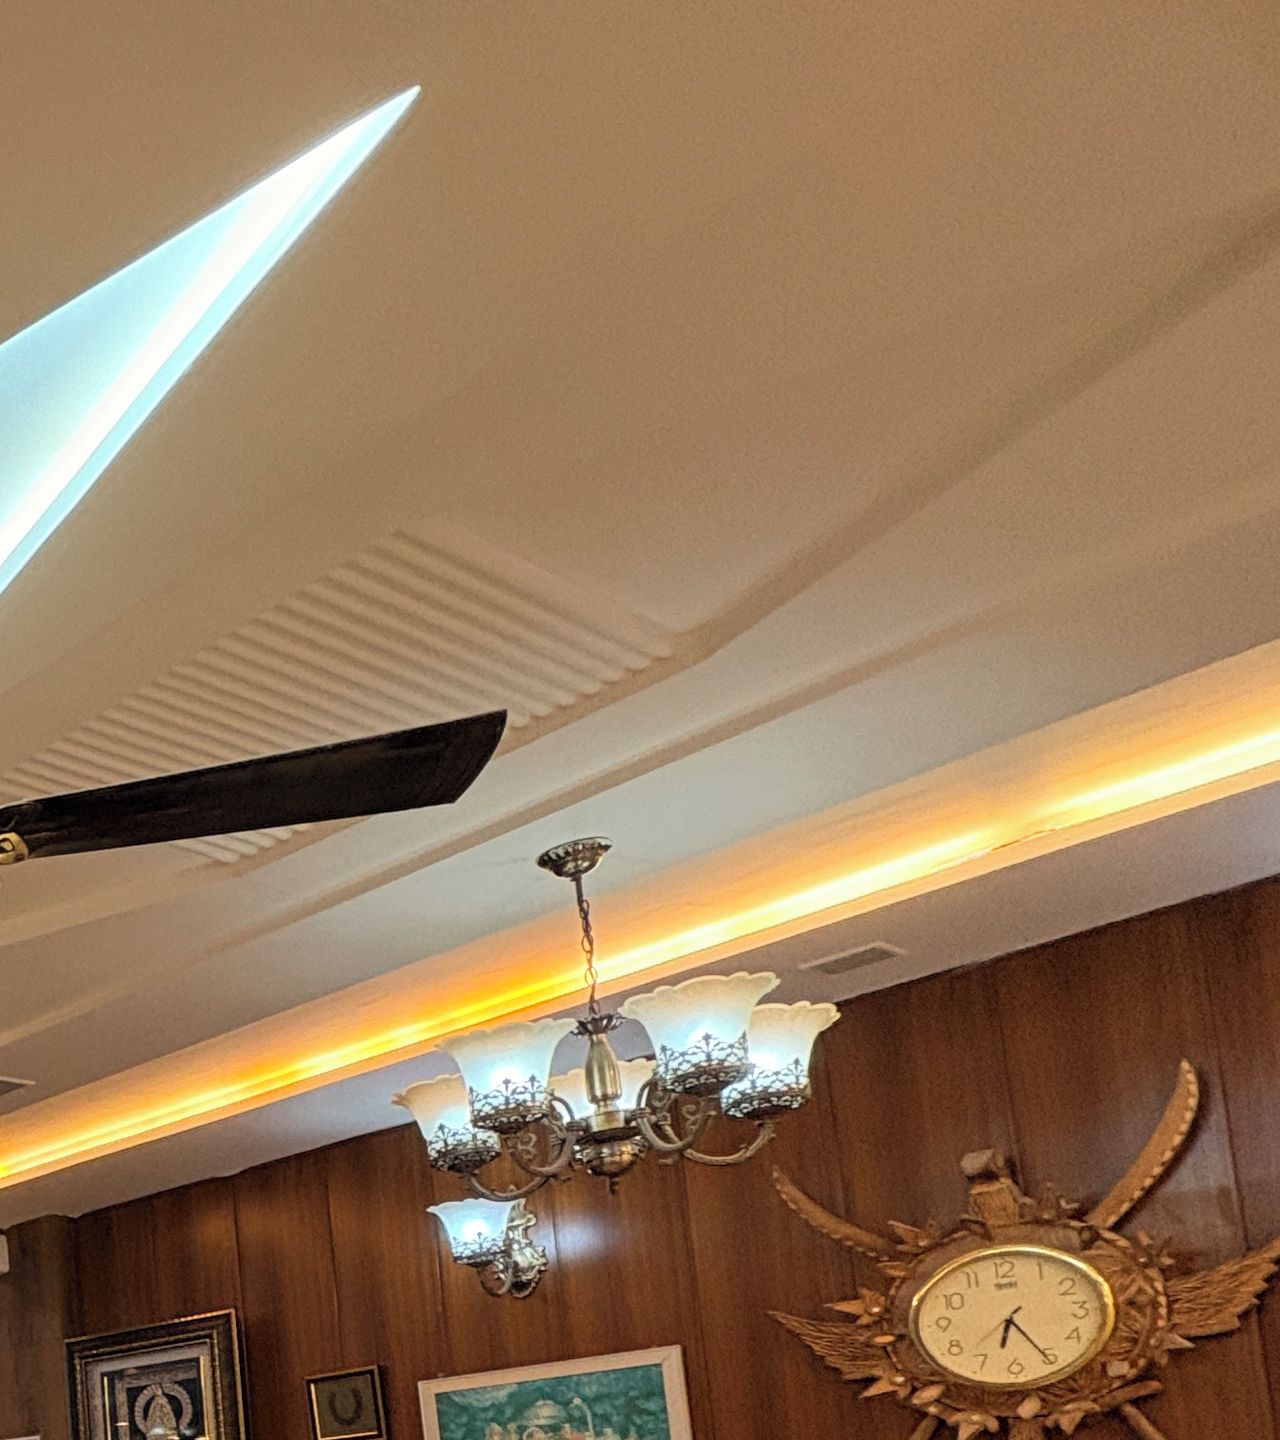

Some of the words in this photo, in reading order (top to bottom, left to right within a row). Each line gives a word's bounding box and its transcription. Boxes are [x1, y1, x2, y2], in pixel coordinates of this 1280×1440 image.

[993, 1259, 1014, 1279] 12
[1036, 1262, 1043, 1279] 1
[963, 1271, 979, 1288] 11
[1058, 1277, 1076, 1296] 2
[942, 1292, 964, 1310] 10
[1071, 1300, 1090, 1319] 3
[935, 1316, 951, 1333] 9
[1064, 1327, 1081, 1343] 4
[947, 1339, 964, 1356] 8
[975, 1353, 988, 1371] 7
[1007, 1357, 1024, 1375] 6
